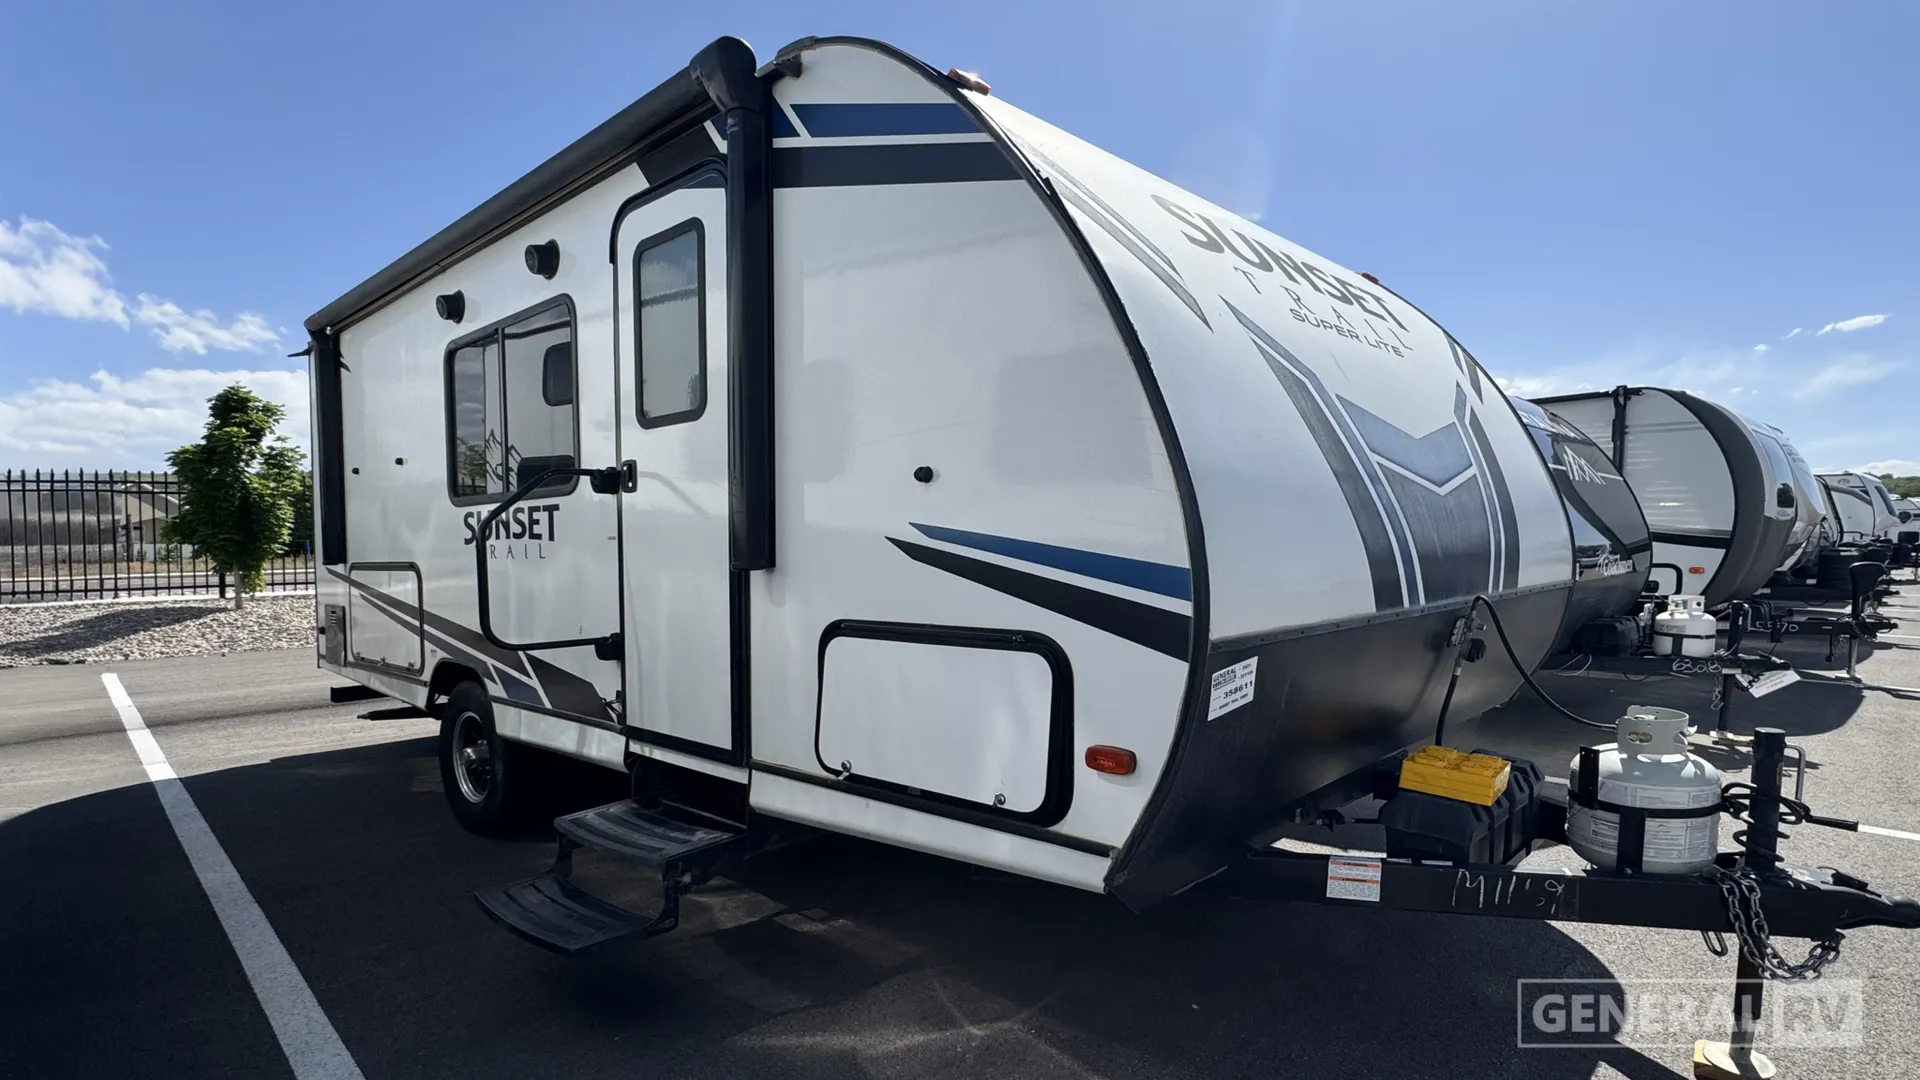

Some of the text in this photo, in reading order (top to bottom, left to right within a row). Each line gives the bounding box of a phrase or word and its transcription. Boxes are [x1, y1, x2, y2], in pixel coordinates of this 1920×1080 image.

[1151, 194, 1410, 332] SUNSET
[1233, 266, 1413, 352] TRAIL
[1290, 307, 1405, 358] SUPER LITE
[489, 543, 547, 560] RAIL
[1223, 680, 1253, 699] 358611
